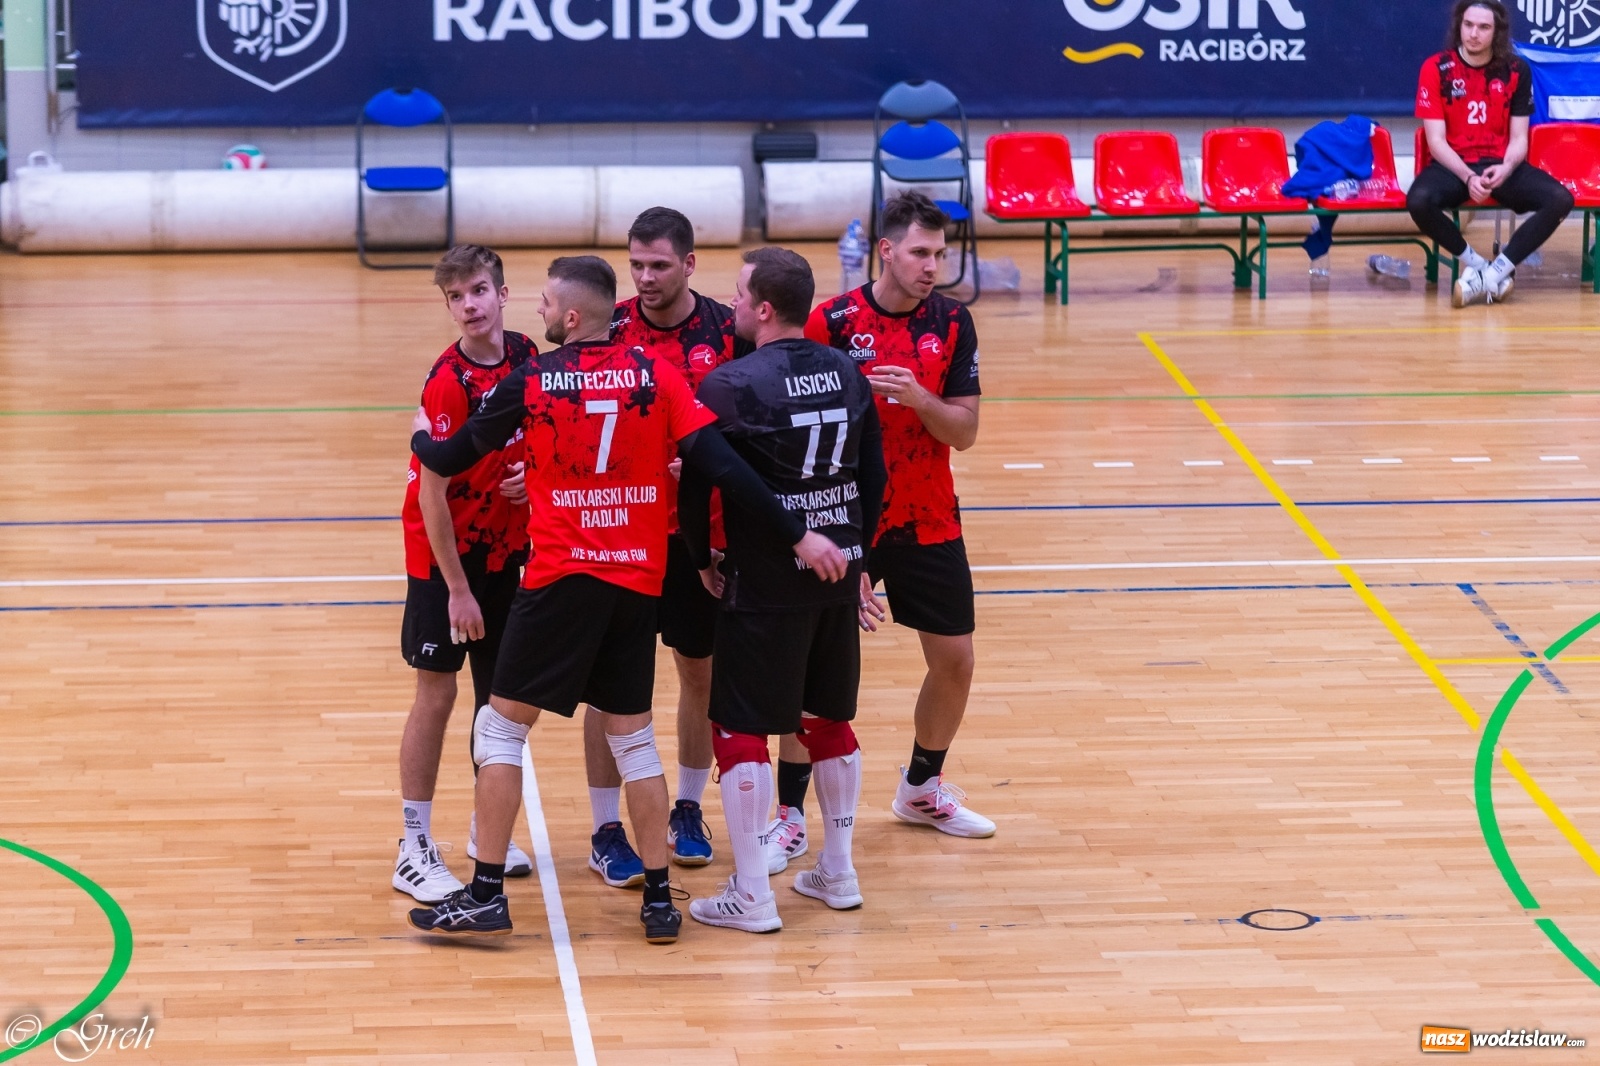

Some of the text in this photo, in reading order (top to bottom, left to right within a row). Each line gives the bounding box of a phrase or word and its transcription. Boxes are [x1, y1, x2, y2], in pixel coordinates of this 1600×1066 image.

[1159, 32, 1306, 61] RACIBÓRZ
[1467, 100, 1487, 124] 23
[848, 347, 876, 358] radlin
[541, 368, 654, 391] BARTECZKO A.
[785, 371, 842, 397] LISICKI
[585, 400, 618, 474] 7
[790, 408, 848, 479] 77
[552, 485, 657, 508] SIATKARSKI KLUB
[581, 508, 629, 528] RADLIN
[805, 506, 850, 529] RADLIN
[570, 547, 648, 562] WE PLAY FOR FUN
[833, 816, 853, 828] TICO
[477, 875, 502, 884] adidas
